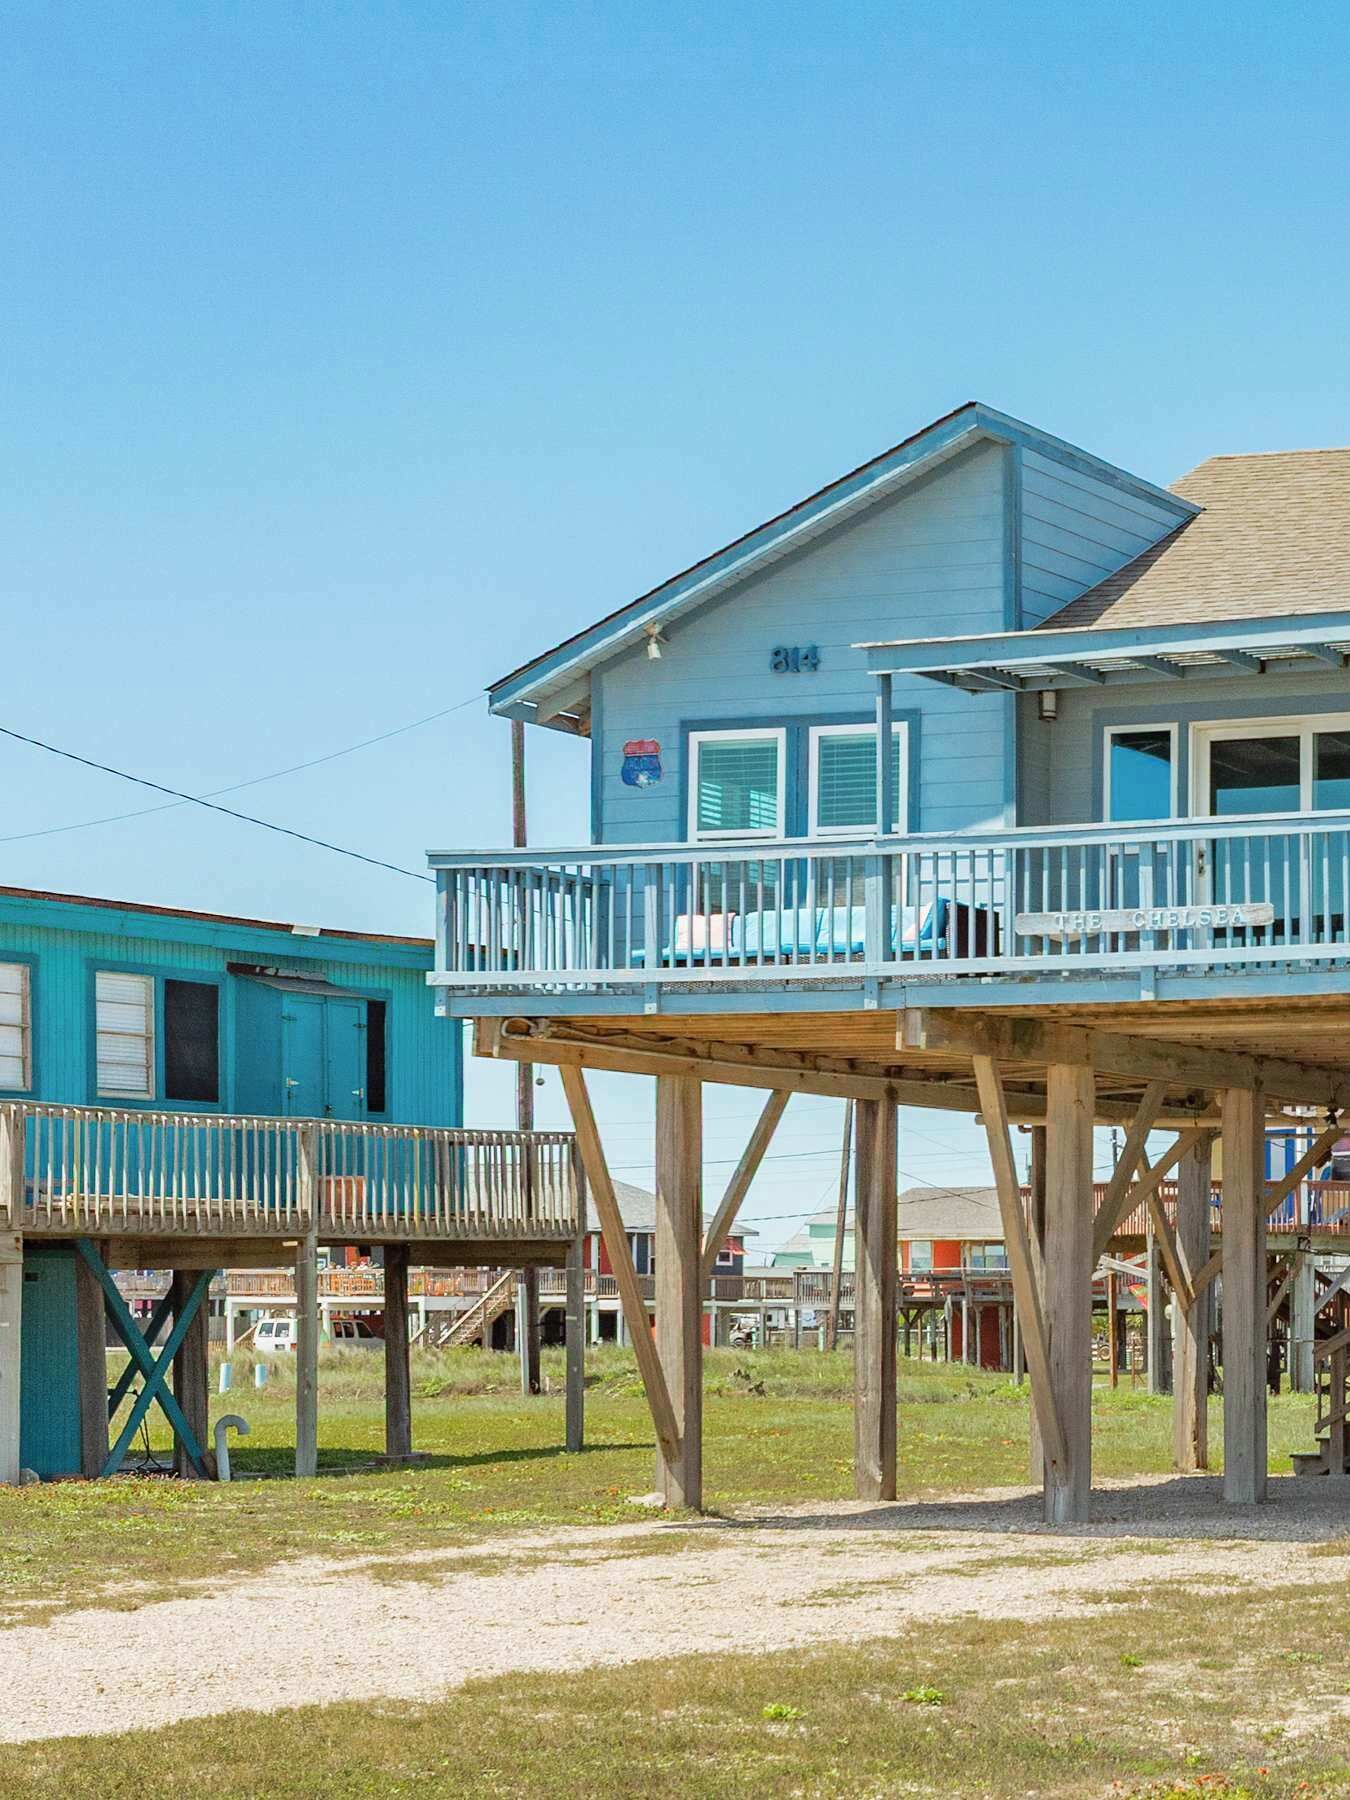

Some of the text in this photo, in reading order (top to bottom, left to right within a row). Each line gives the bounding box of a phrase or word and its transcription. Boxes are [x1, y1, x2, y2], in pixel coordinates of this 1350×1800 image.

[770, 645, 820, 673] 814
[1055, 908, 1248, 931] THE CHELSEA
